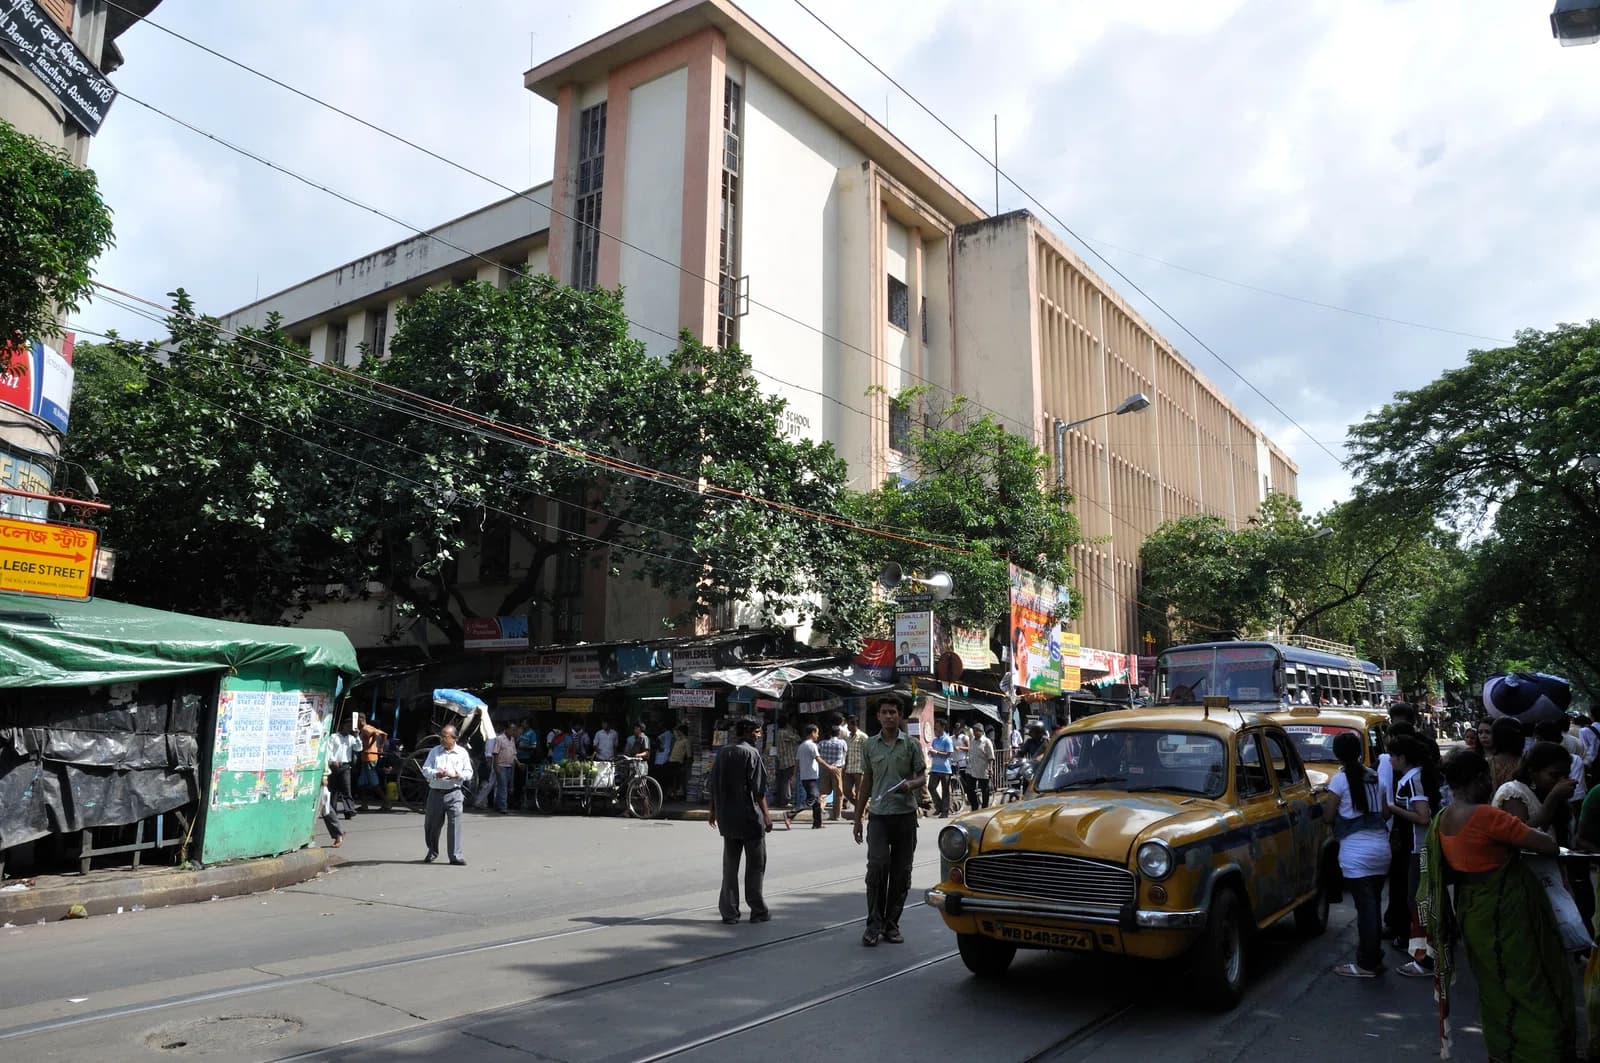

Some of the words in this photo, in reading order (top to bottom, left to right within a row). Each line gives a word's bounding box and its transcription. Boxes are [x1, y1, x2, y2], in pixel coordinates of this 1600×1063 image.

[6, 22, 38, 58] Bengal
[37, 51, 68, 90] Teachers
[67, 85, 103, 124] Association
[786, 411, 811, 428] SCHOOL
[0, 525, 47, 544] লেজ
[0, 558, 37, 575] LEGE
[38, 563, 85, 580] STREET
